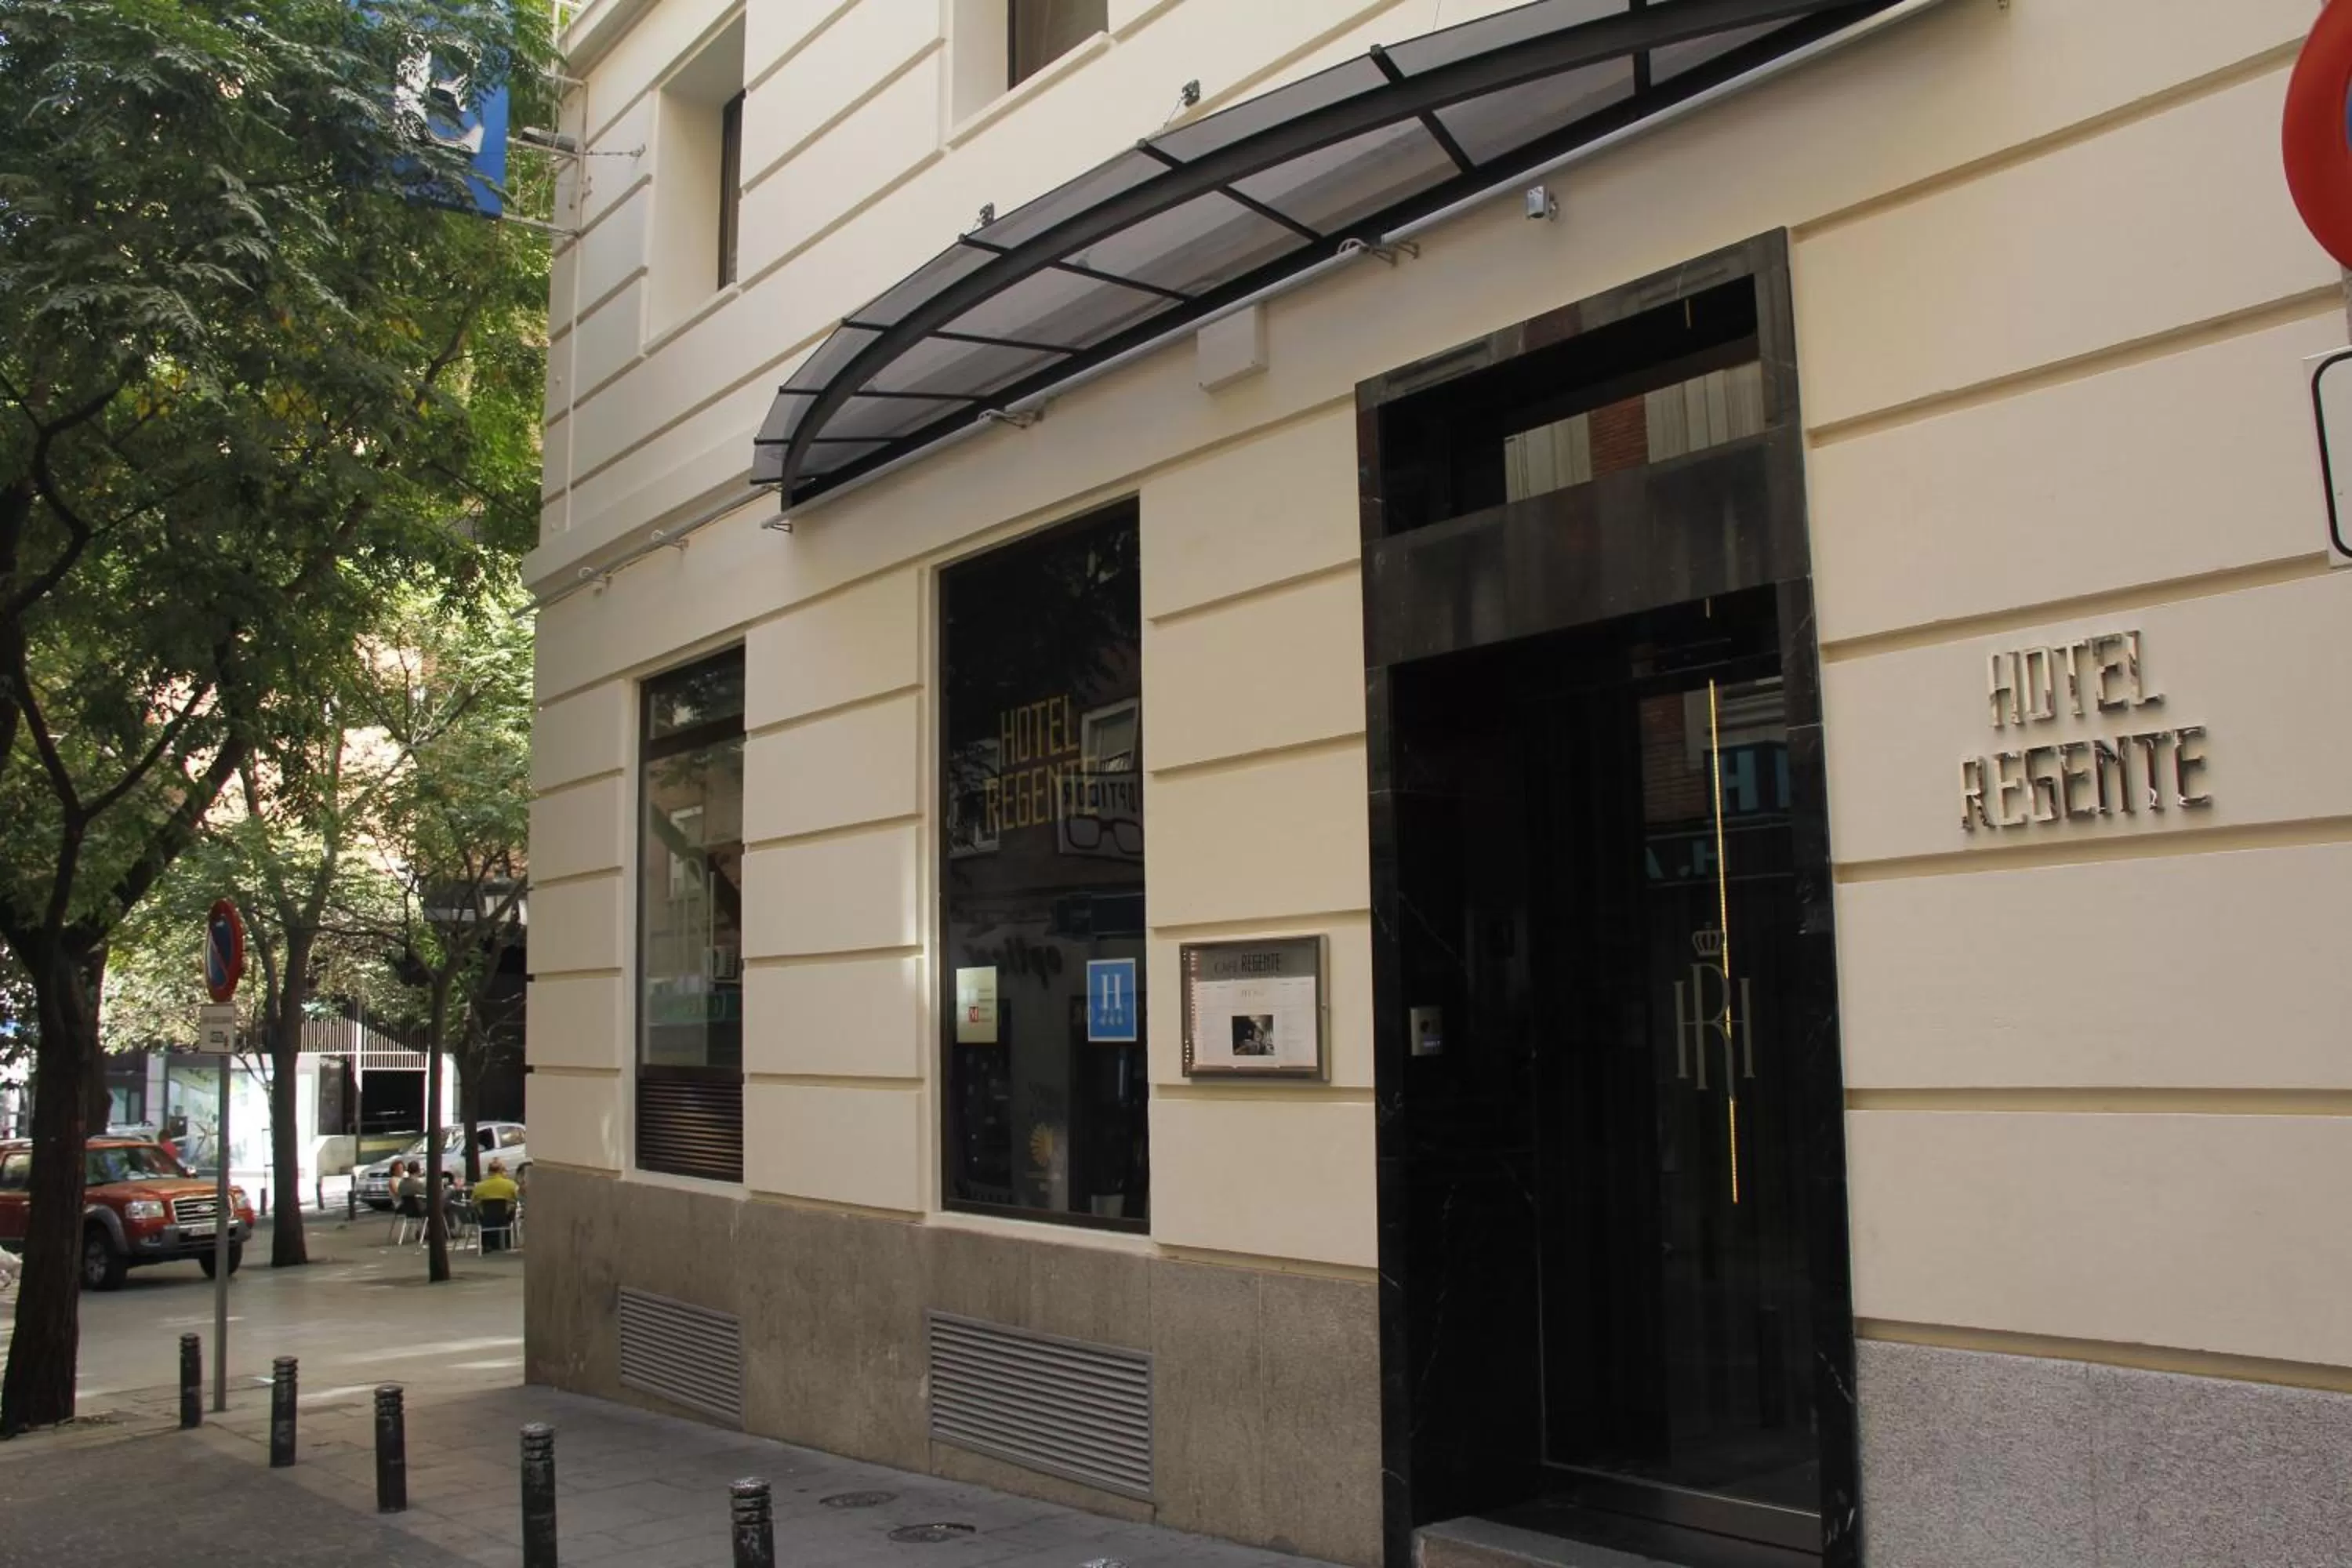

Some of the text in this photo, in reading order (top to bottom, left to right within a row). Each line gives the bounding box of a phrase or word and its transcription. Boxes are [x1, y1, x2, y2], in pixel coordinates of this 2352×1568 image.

[1987, 630, 2166, 729] HOTEL
[1000, 693, 1080, 766] HOTEL
[985, 757, 1098, 834] REGENTE
[1962, 724, 2213, 832] REGENTE
